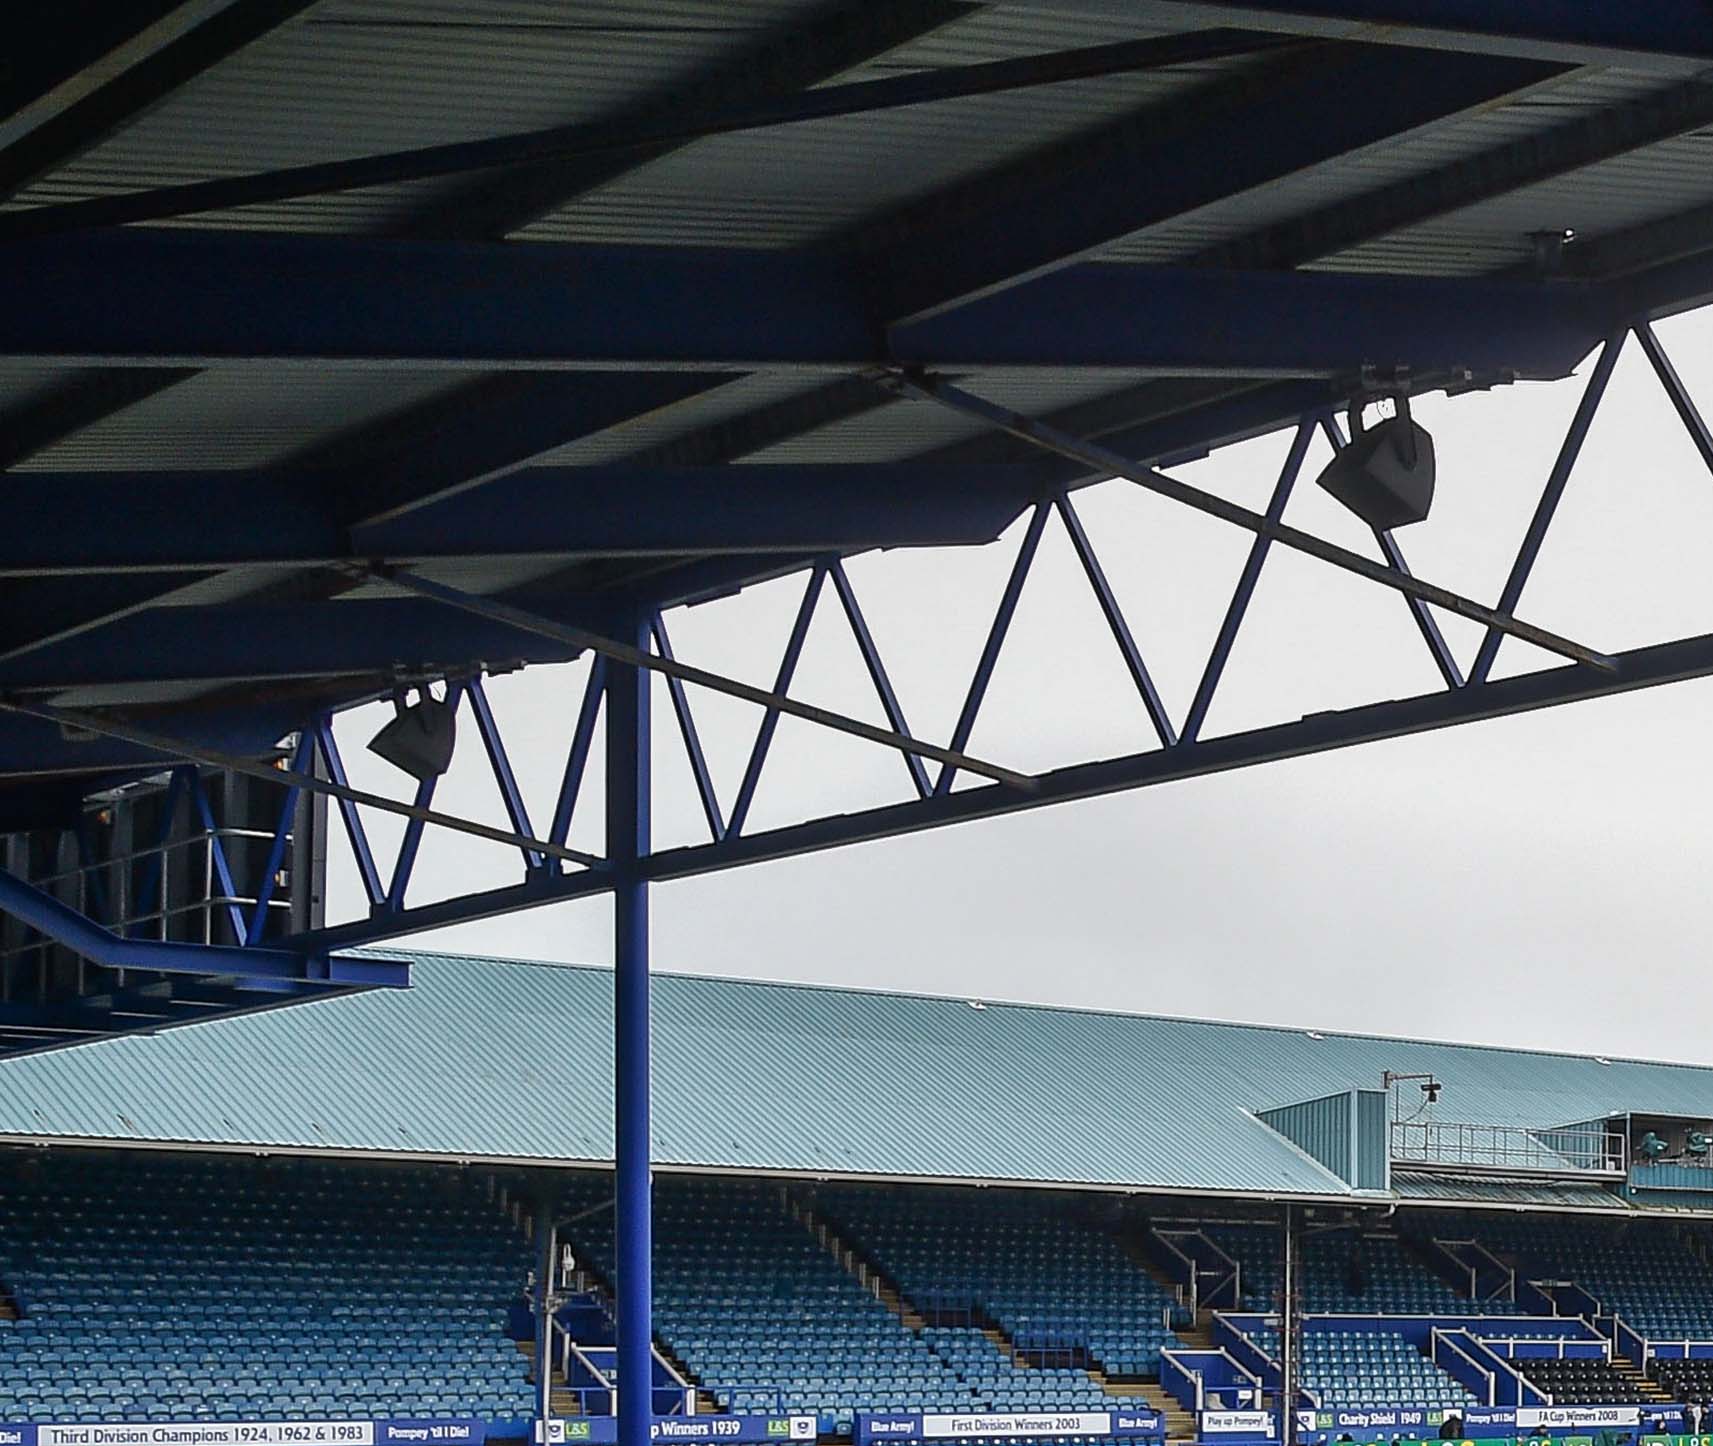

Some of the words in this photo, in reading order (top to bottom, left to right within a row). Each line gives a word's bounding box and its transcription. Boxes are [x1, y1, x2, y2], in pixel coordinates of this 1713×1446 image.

[1208, 1416, 1222, 1428] Play
[1223, 1418, 1232, 1428] up
[1234, 1415, 1264, 1427] Pompey!
[1339, 1413, 1369, 1426] Charity
[1370, 1412, 1395, 1424] Shield
[1401, 1413, 1421, 1424] 1949
[1538, 1410, 1549, 1421] FA
[1551, 1410, 1565, 1422] Cup
[1566, 1408, 1595, 1420] Winners
[566, 1423, 589, 1433] L&S
[661, 1422, 708, 1435] Winners
[712, 1421, 740, 1435] 1939
[768, 1420, 790, 1431] L&S
[952, 1419, 972, 1431] First
[975, 1418, 1012, 1431] Division
[1015, 1418, 1053, 1430] Winners
[1055, 1417, 1080, 1429] 2003
[52, 1429, 91, 1444] Third
[94, 1428, 148, 1445] Division
[153, 1427, 229, 1445] Champions
[234, 1427, 272, 1444] 1924,
[278, 1426, 311, 1440] 1962
[315, 1426, 327, 1440] &
[332, 1425, 363, 1440] 1983
